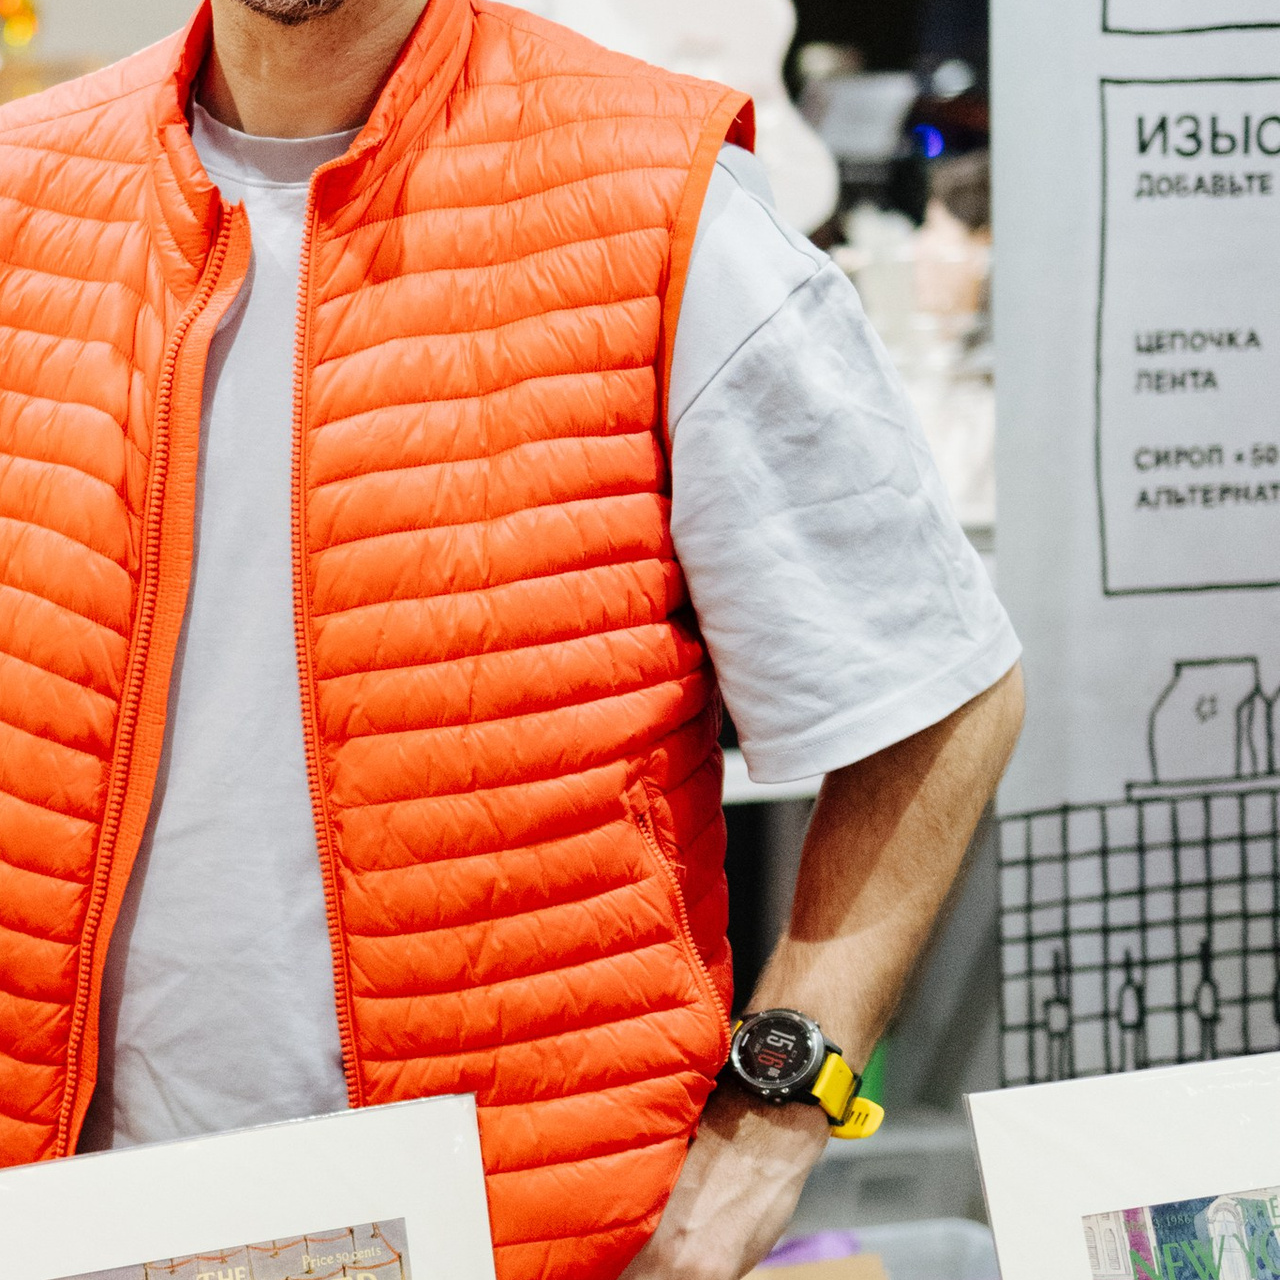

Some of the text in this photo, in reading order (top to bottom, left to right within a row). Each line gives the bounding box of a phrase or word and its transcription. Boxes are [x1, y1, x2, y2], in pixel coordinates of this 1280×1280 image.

[1136, 172, 1273, 198] ДОБАВЬТЕ
[1135, 329, 1261, 354] ЦЕПОЧКА
[1135, 369, 1219, 394] ЛЕНТА
[1135, 443, 1223, 471] СИРОП
[302, 1246, 382, 1269] Price 50 cents
